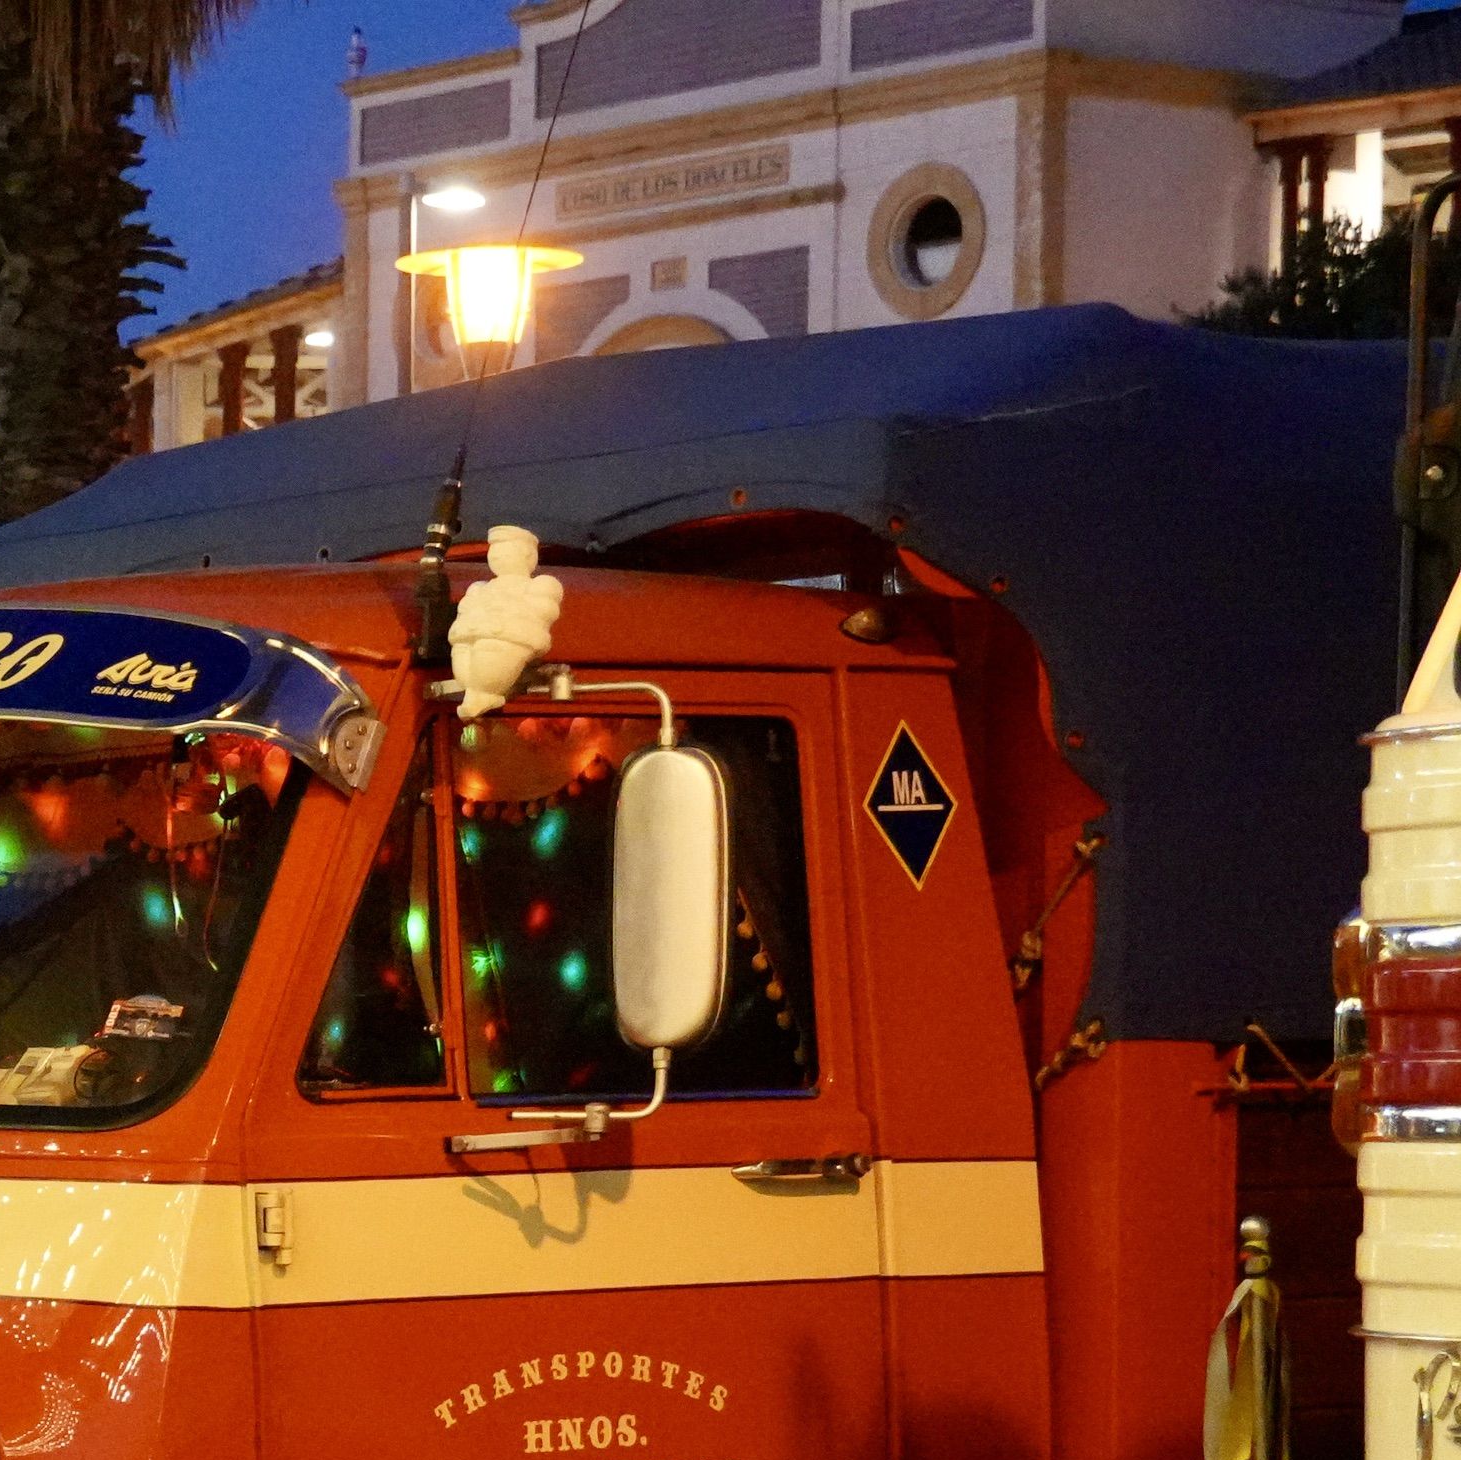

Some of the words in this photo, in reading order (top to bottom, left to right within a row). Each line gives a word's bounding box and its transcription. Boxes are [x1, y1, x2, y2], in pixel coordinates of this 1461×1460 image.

[117, 687, 134, 698] SU
[891, 770, 927, 804] MA
[434, 1351, 728, 1428] TRANSPORTES
[523, 1414, 648, 1454] HNOS.
